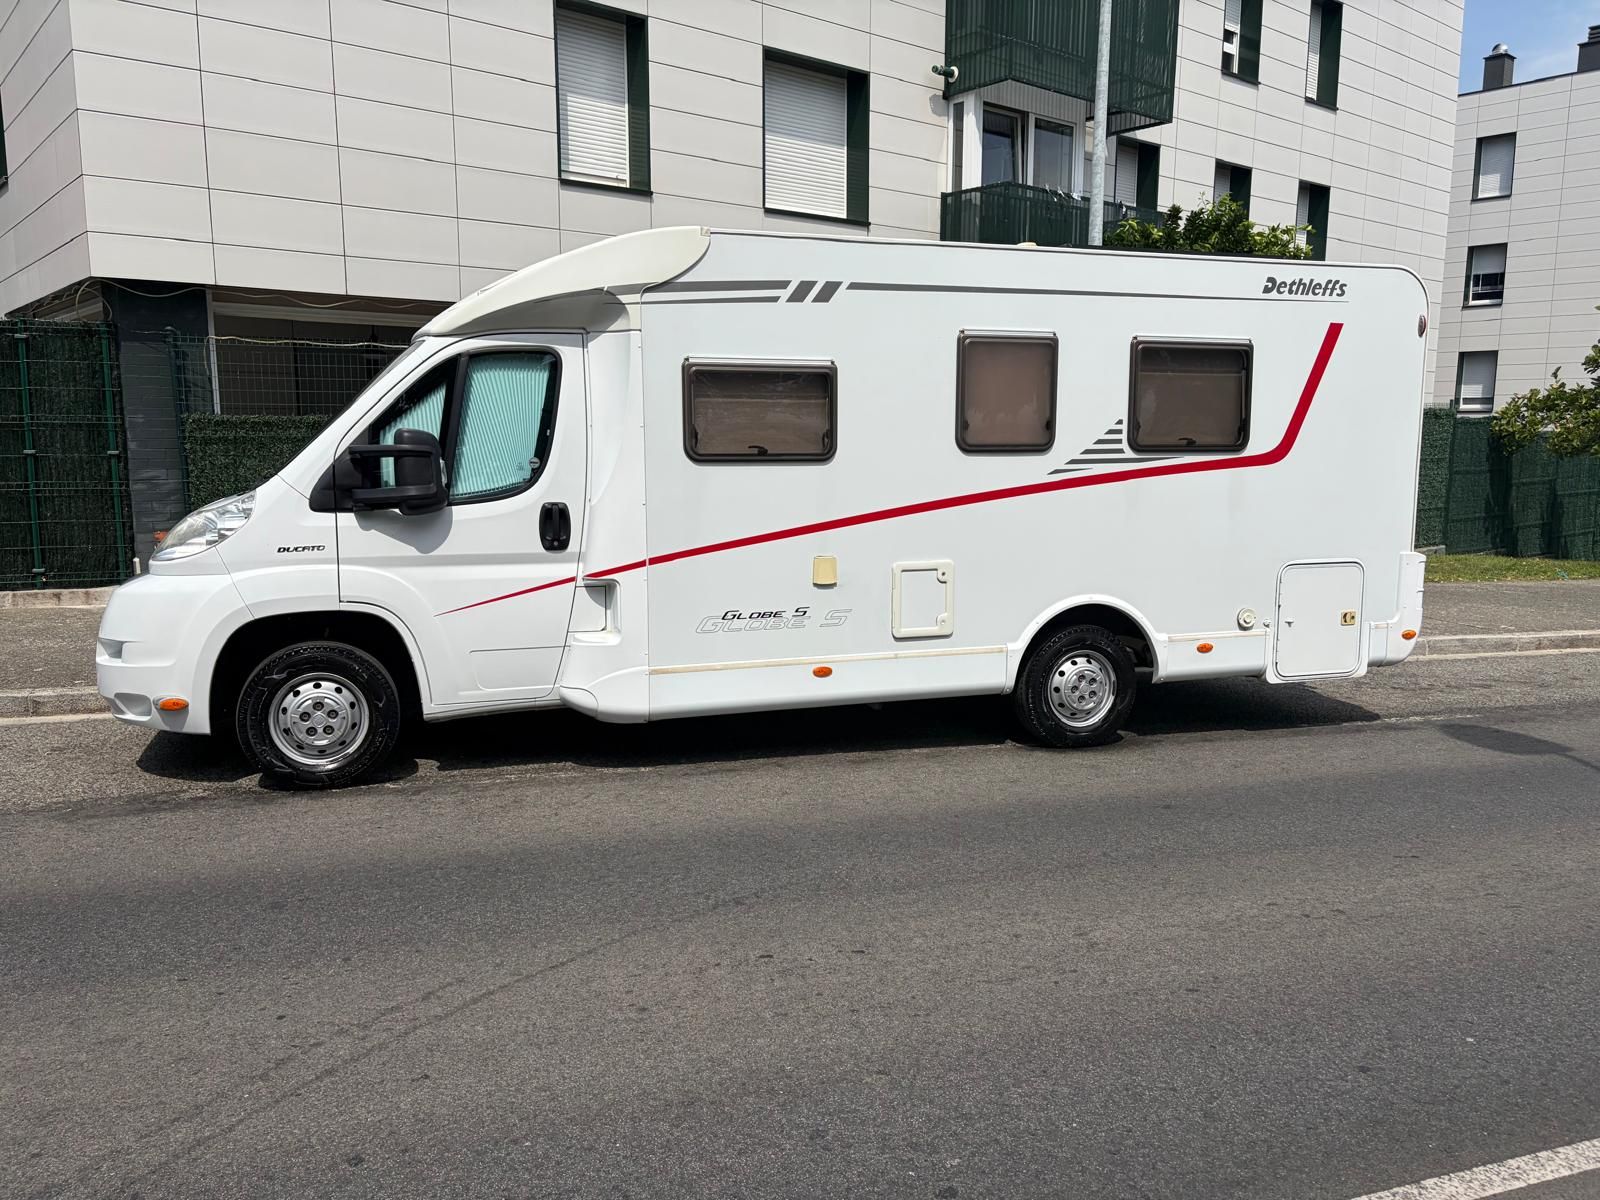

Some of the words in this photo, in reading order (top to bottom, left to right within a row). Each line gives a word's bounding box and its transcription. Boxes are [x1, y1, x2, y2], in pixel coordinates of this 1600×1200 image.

[1262, 276, 1347, 297] Dethleffs
[277, 545, 325, 553] DUCATO
[792, 607, 810, 617] S
[819, 609, 853, 628] S
